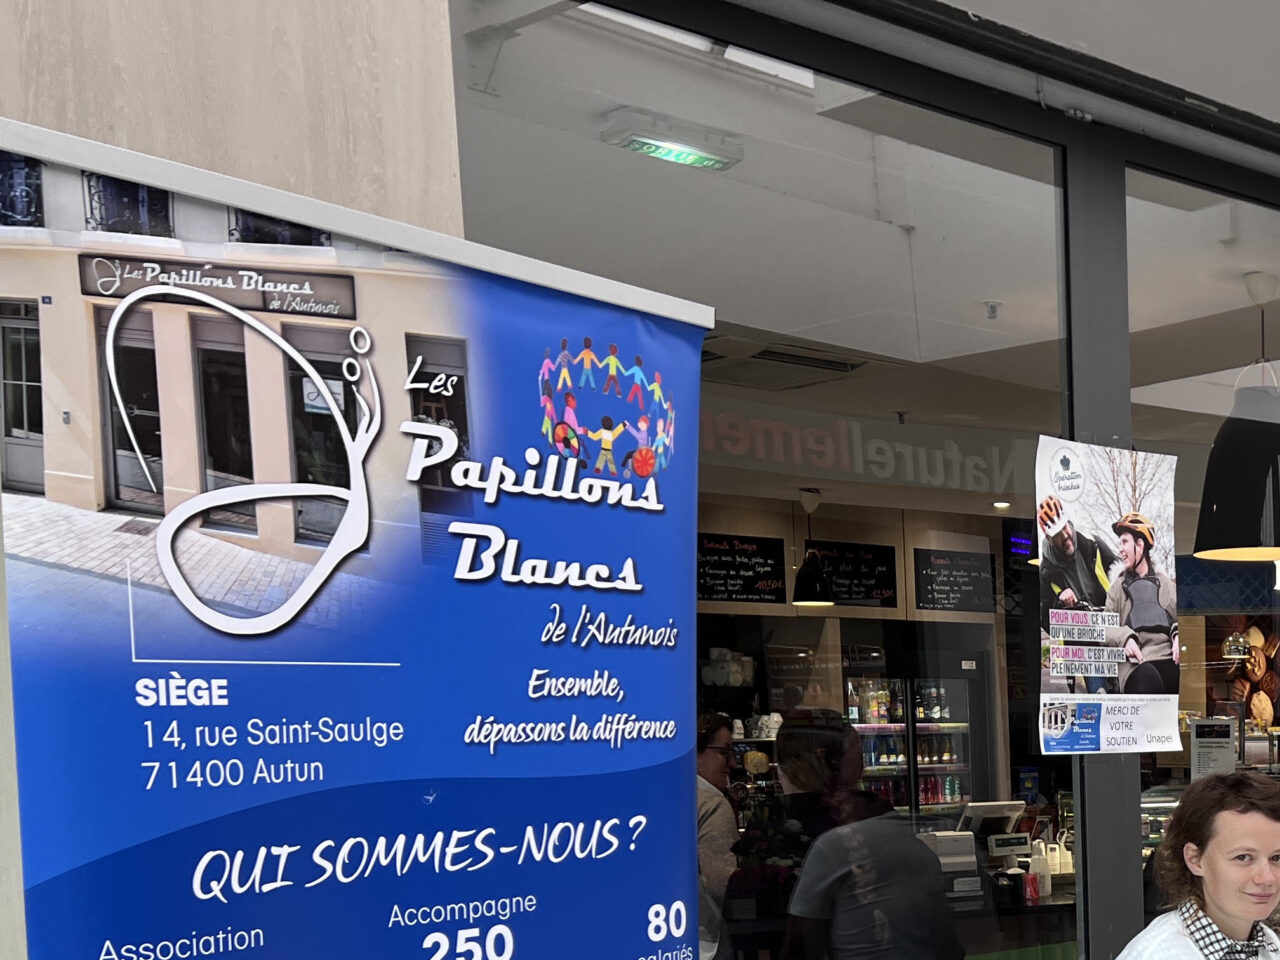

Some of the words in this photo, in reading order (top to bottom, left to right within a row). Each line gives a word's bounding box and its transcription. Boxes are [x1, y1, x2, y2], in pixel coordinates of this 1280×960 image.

[124, 264, 142, 279] Les
[143, 263, 236, 289] Papillons
[238, 270, 314, 294] Blancs
[269, 293, 280, 310] de
[283, 296, 341, 315] l'Autunois
[403, 355, 457, 397] Les
[400, 422, 664, 511] Papillons
[448, 521, 642, 592] Blancs
[540, 605, 566, 643] de
[571, 606, 678, 647] l'Autunois
[1051, 612, 1069, 625] POUR
[1077, 628, 1105, 640] BRIOCHE
[1051, 647, 1069, 660] POUR
[1106, 648, 1125, 661] VIVRE
[1051, 662, 1092, 675] PLEINEMENT
[1094, 663, 1105, 675] MA
[1106, 663, 1117, 675] VIE
[135, 671, 228, 706] SIÈGE
[528, 669, 625, 703] Ensemble,
[1105, 705, 1126, 716] MERCI
[1110, 721, 1134, 732] VOTRE
[143, 720, 187, 750] 14,
[195, 722, 238, 748] rue
[247, 717, 404, 748] Saint-Saulge
[464, 717, 566, 755] dépassons
[569, 716, 591, 742] la
[593, 715, 676, 750] différence
[1107, 736, 1137, 747] SOUTIEN
[141, 759, 245, 790] 71400
[252, 758, 325, 785] Autun
[191, 845, 299, 903] QUI
[305, 818, 619, 889] SOMMES-NOUS
[388, 894, 536, 930] Accompagne
[646, 900, 687, 942] 80
